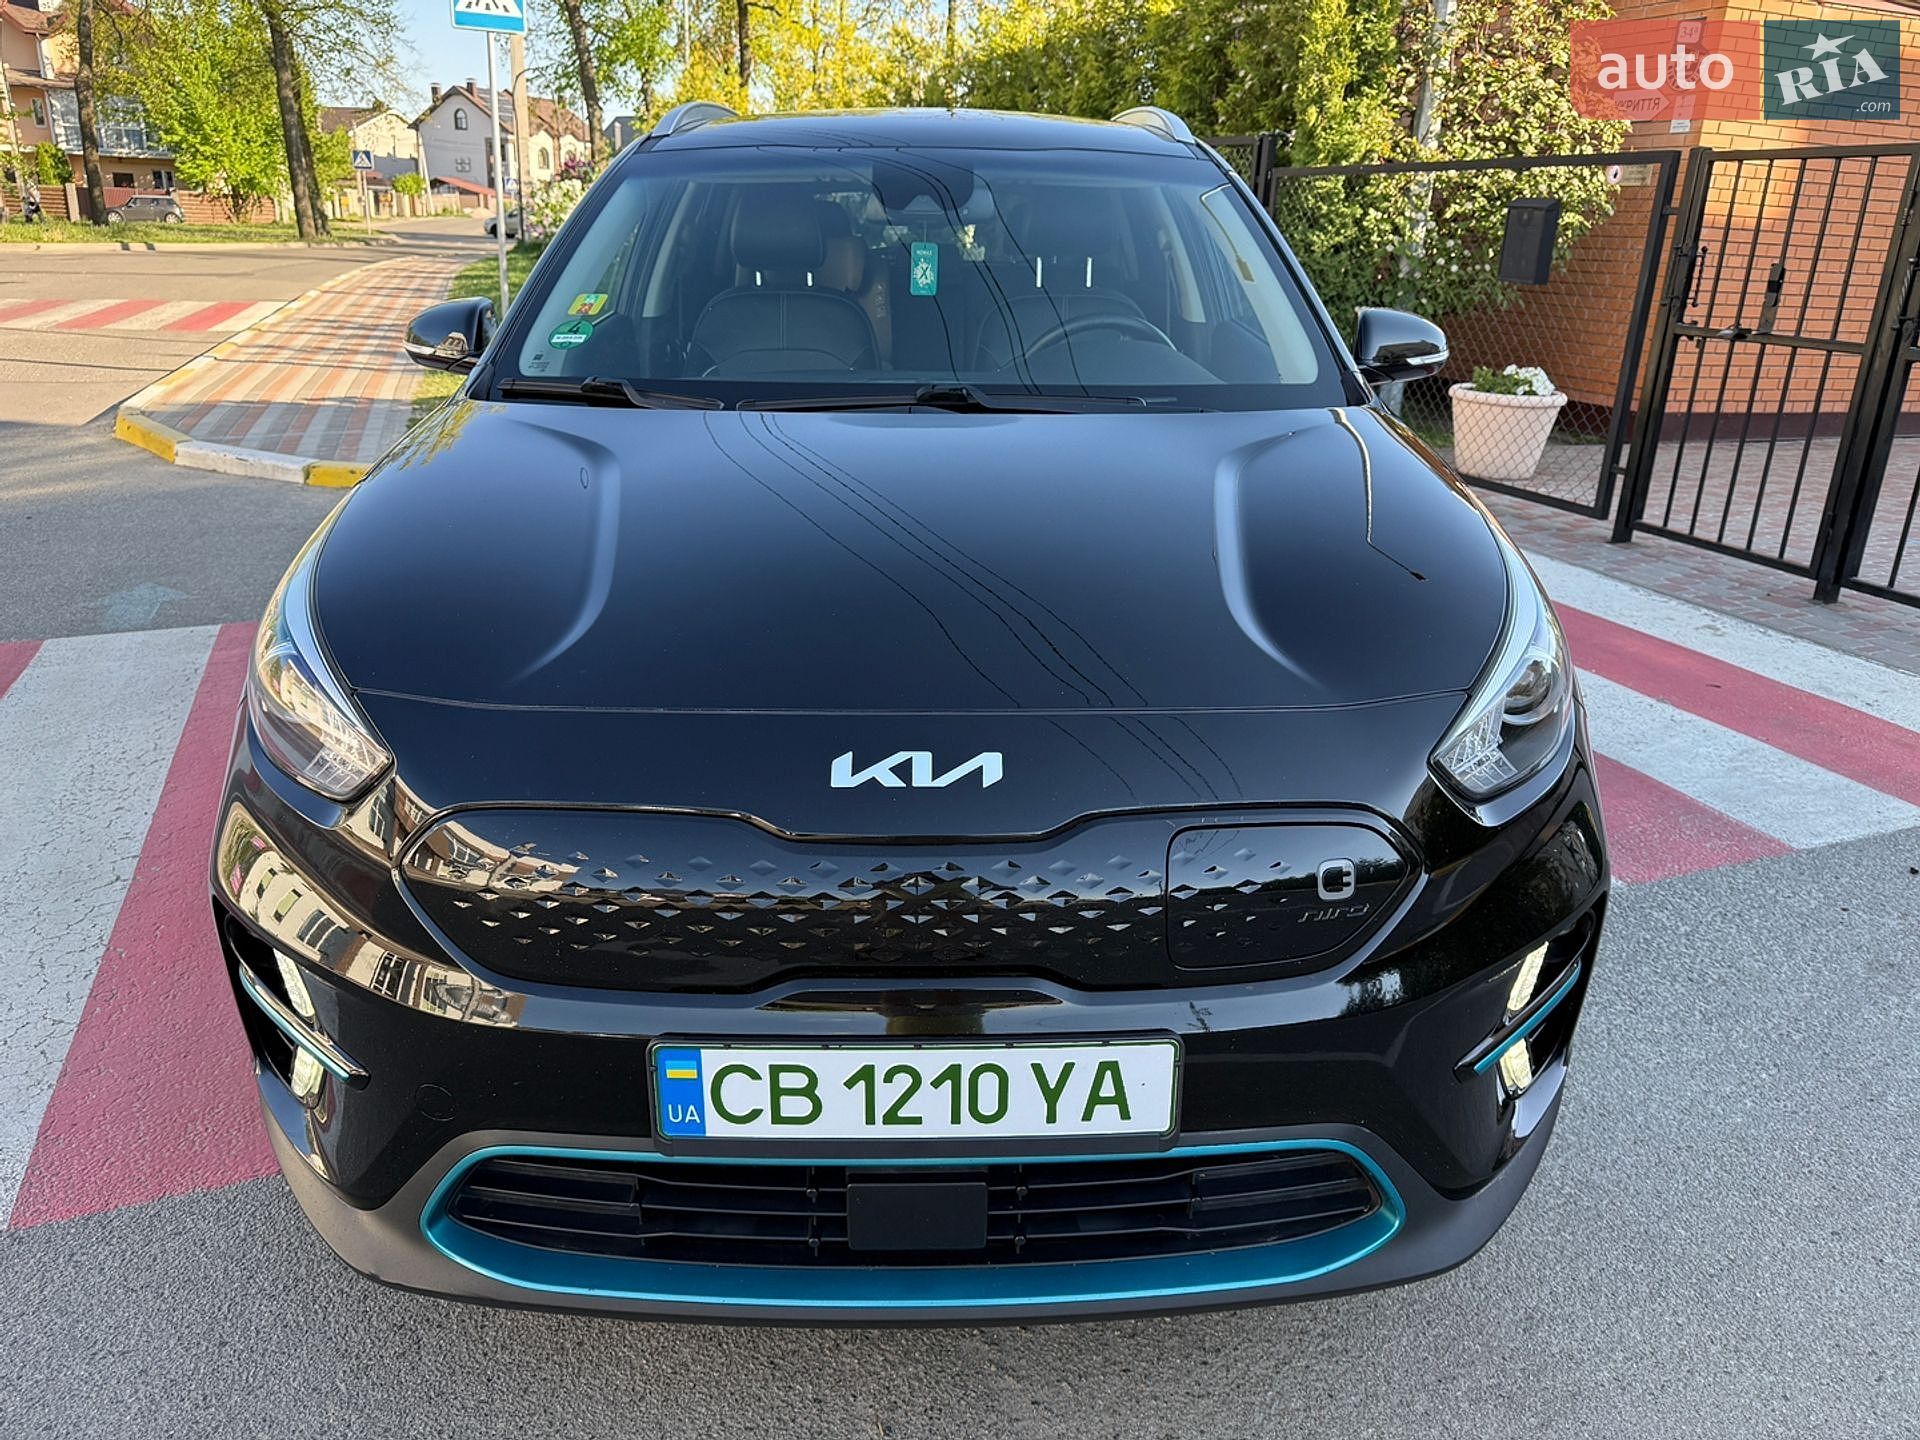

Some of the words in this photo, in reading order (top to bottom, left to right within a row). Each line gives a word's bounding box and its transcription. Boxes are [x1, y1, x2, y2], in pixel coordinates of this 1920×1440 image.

[567, 321, 582, 334] 4
[831, 751, 1003, 788] KIA
[710, 1064, 823, 1125] CB
[843, 1062, 1010, 1126] 1210
[1030, 1060, 1132, 1124] YA
[668, 1104, 700, 1123] UA
